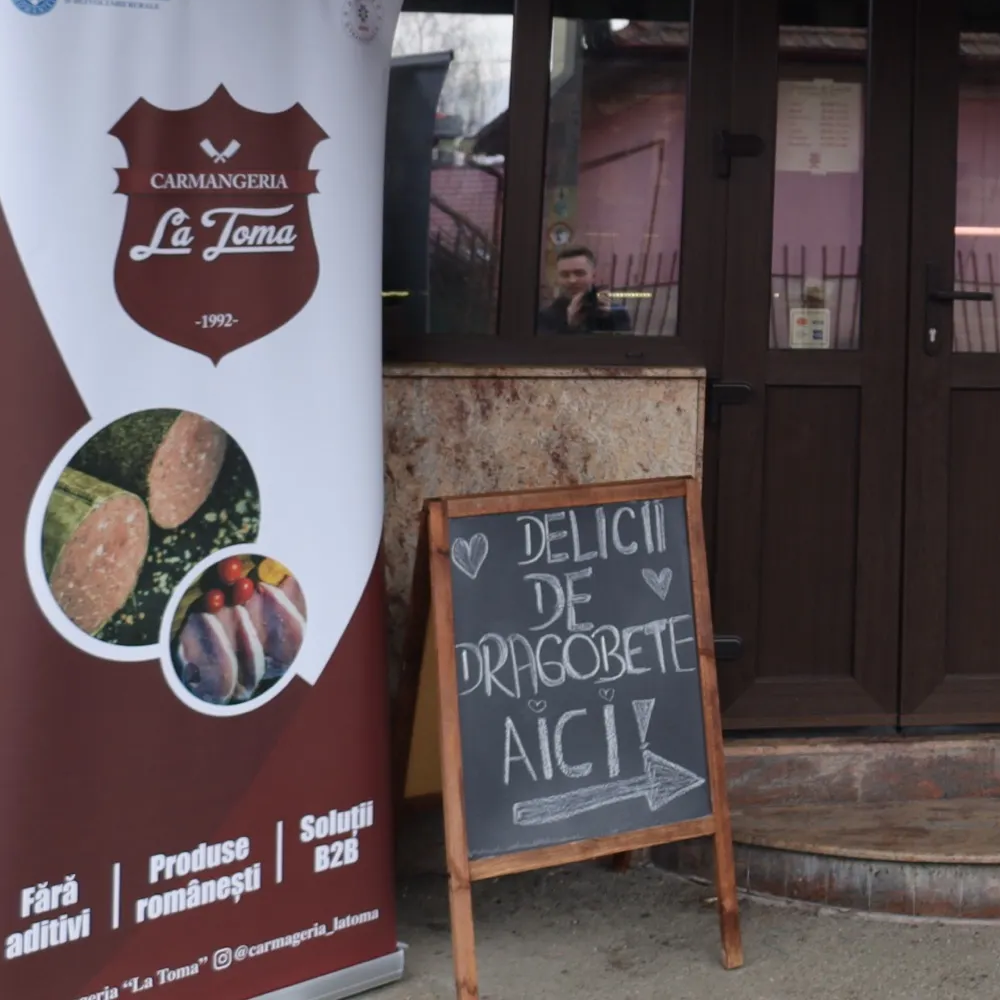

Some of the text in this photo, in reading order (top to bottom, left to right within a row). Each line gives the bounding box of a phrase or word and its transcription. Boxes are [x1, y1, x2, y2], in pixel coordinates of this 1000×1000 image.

[150, 172, 289, 190] CARMANGERIA
[129, 203, 298, 262] La Toma
[516, 500, 667, 566] DELICII
[523, 567, 594, 631] DE
[455, 614, 697, 699] DRAGOBETE
[148, 835, 251, 885] Produse
[313, 837, 360, 873] B2B
[20, 872, 79, 918] Fără
[135, 862, 262, 924] românești
[4, 907, 91, 960] aditivi
[233, 907, 380, 963] @carmageria_latoma
